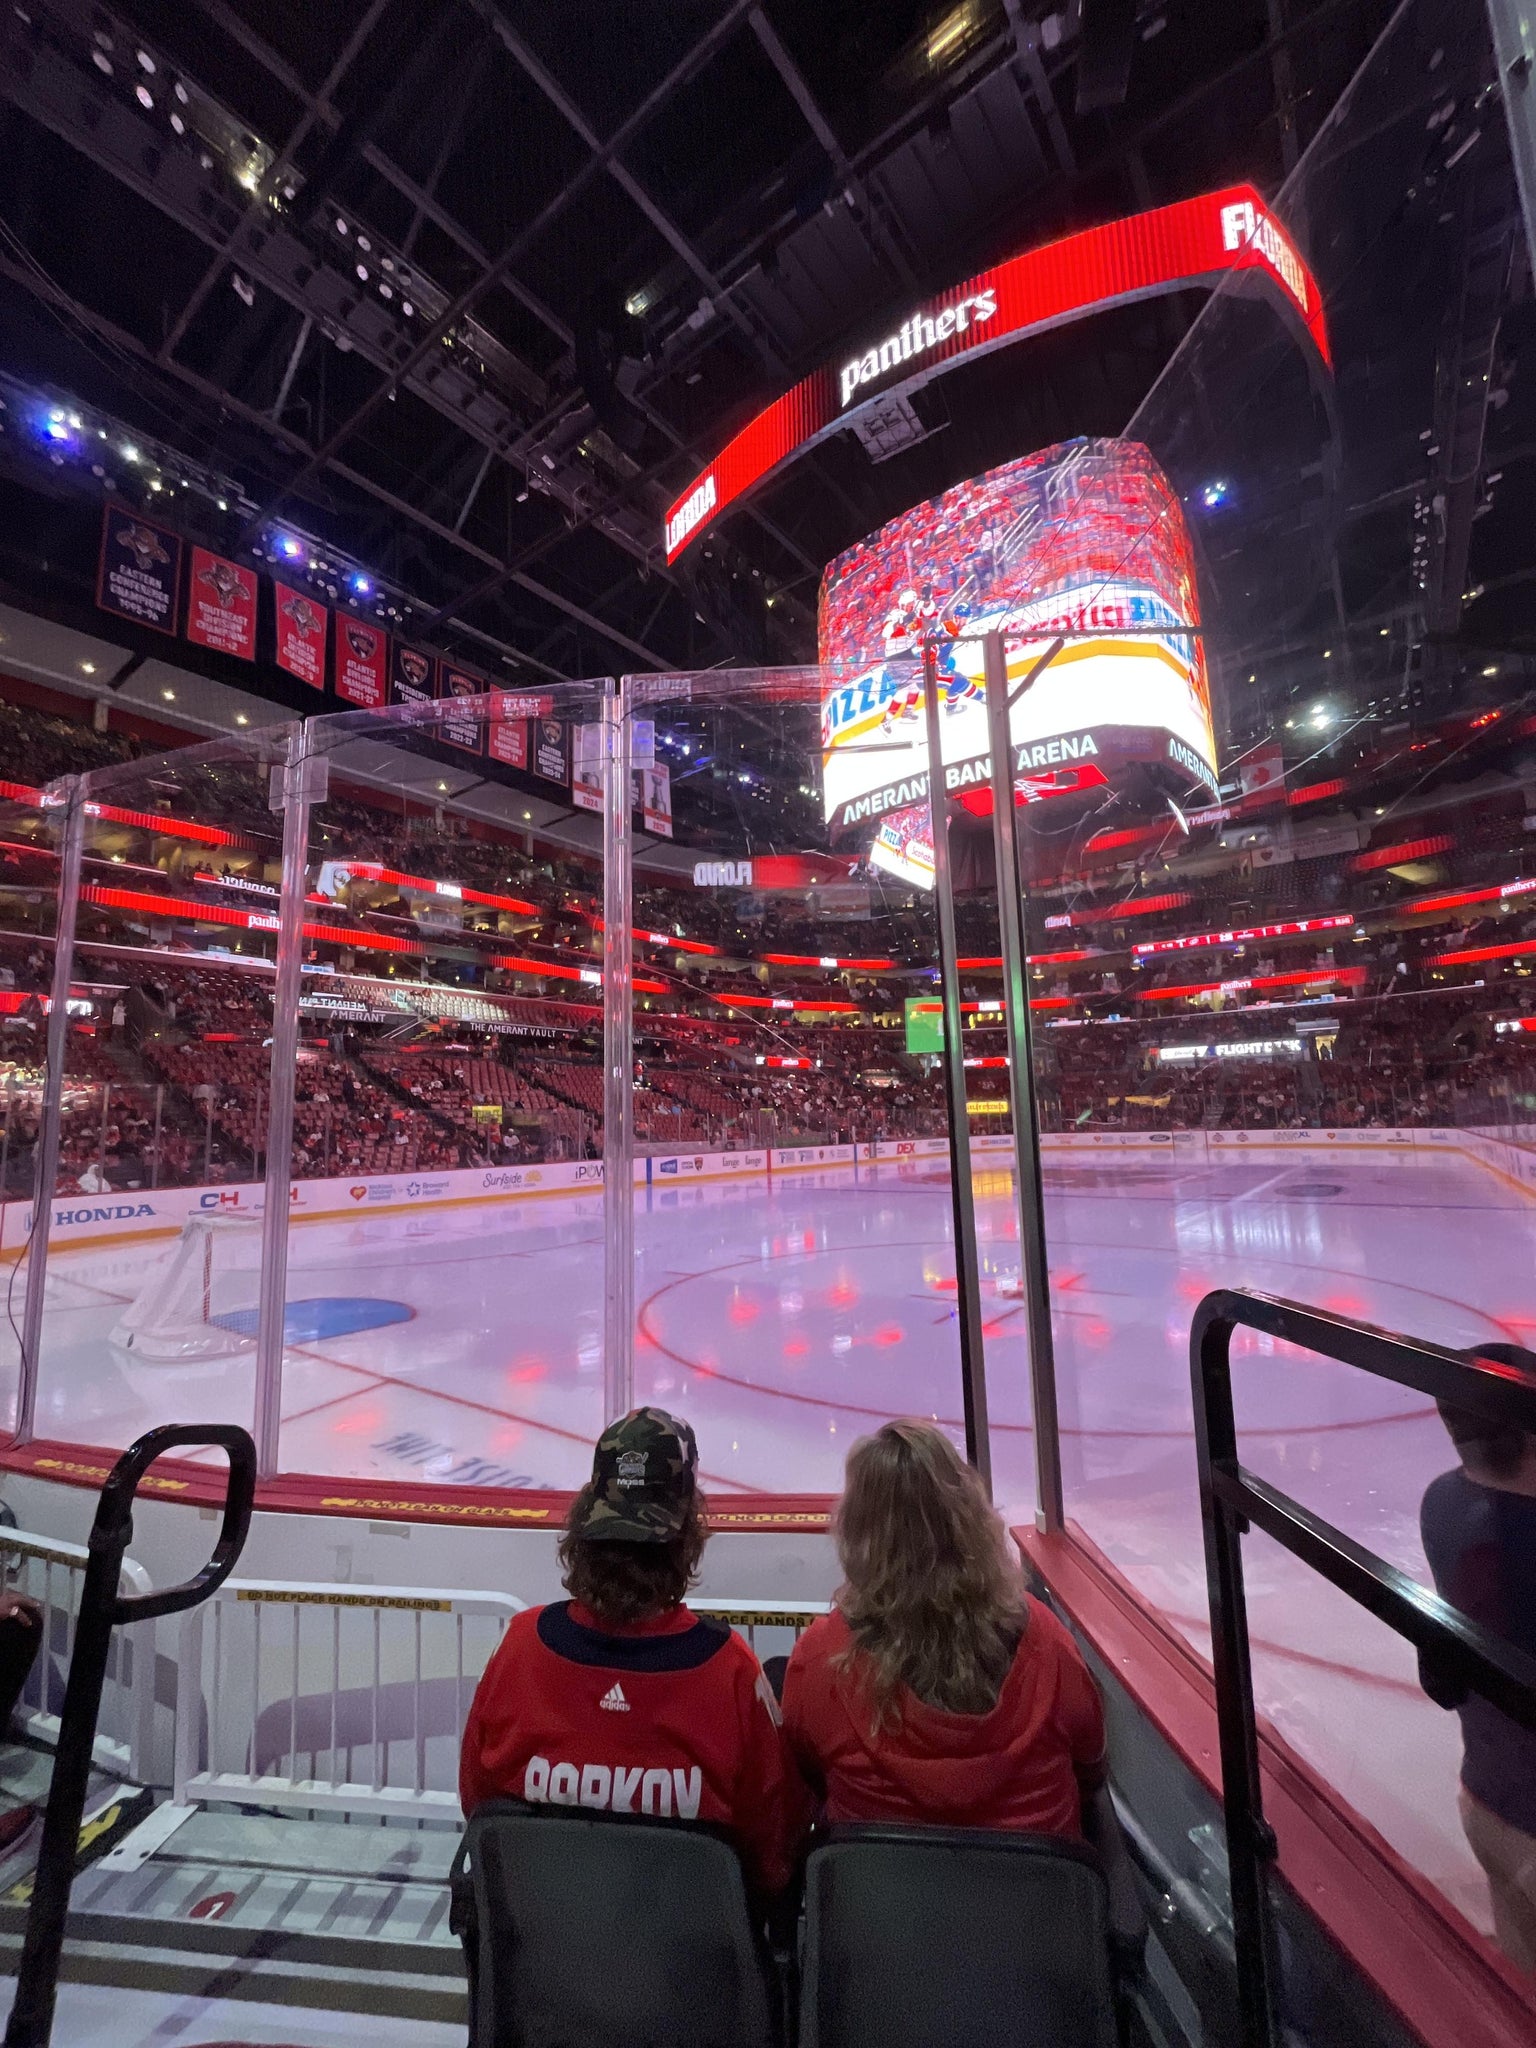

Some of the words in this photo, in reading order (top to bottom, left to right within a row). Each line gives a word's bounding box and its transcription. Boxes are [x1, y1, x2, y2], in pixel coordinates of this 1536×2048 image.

[841, 289, 998, 408] panthers
[843, 775, 930, 825] AMERAN
[1017, 734, 1098, 771] ARENA
[583, 797, 598, 808] 2024
[1501, 880, 1536, 896] panthers
[1220, 980, 1252, 991] panthers
[331, 1010, 386, 1022] AMERANT
[470, 1022, 486, 1032] THE
[488, 1024, 528, 1036] AMERANT
[531, 1027, 556, 1038] VAULT
[1216, 1043, 1263, 1056] FLIGHT
[897, 1142, 916, 1155] DEX
[483, 1172, 522, 1188] Surfside
[201, 1192, 239, 1208] CH
[56, 1203, 156, 1226] HONDA
[353, 1499, 373, 1508] DO
[375, 1500, 404, 1509] NOT
[406, 1502, 440, 1511] LEAN
[444, 1505, 463, 1513] ON
[466, 1507, 510, 1516] GLASS
[247, 1591, 263, 1600] DO
[266, 1592, 288, 1601] NOT
[291, 1593, 325, 1604] PLACE
[328, 1595, 365, 1606] HANDS
[370, 1597, 386, 1606] ON
[389, 1598, 441, 1610] RAILINGS
[753, 1616, 805, 1627] HANDS
[600, 1700, 631, 1712] adidas
[525, 1755, 702, 1820] BARKOV
